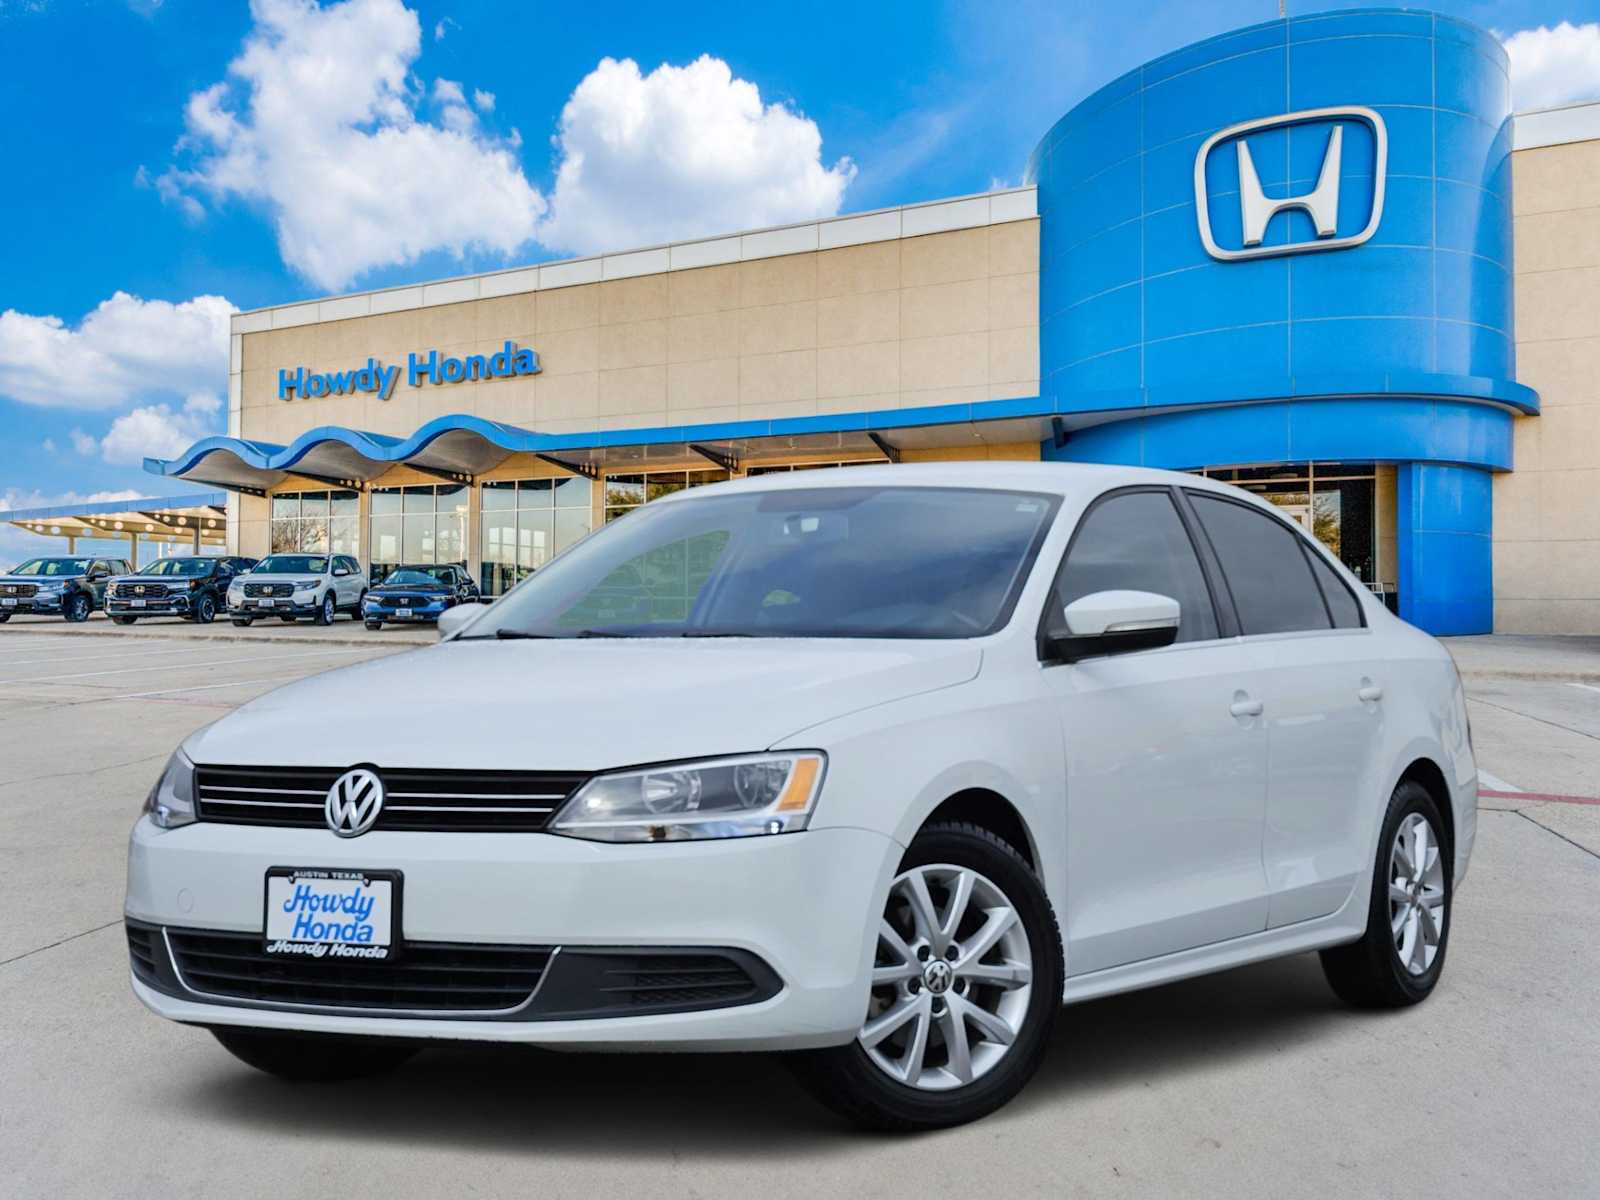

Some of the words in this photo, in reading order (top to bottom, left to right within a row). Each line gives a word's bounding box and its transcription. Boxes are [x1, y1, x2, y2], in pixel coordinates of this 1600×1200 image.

[278, 358, 400, 400] Howdy
[408, 340, 542, 387] Honda
[294, 870, 328, 879] AUSTIN
[332, 871, 364, 880] TEXAS
[283, 885, 375, 922] Howdy
[292, 912, 374, 942] Honda
[267, 941, 328, 957] Howdy
[329, 943, 388, 958] Honda
